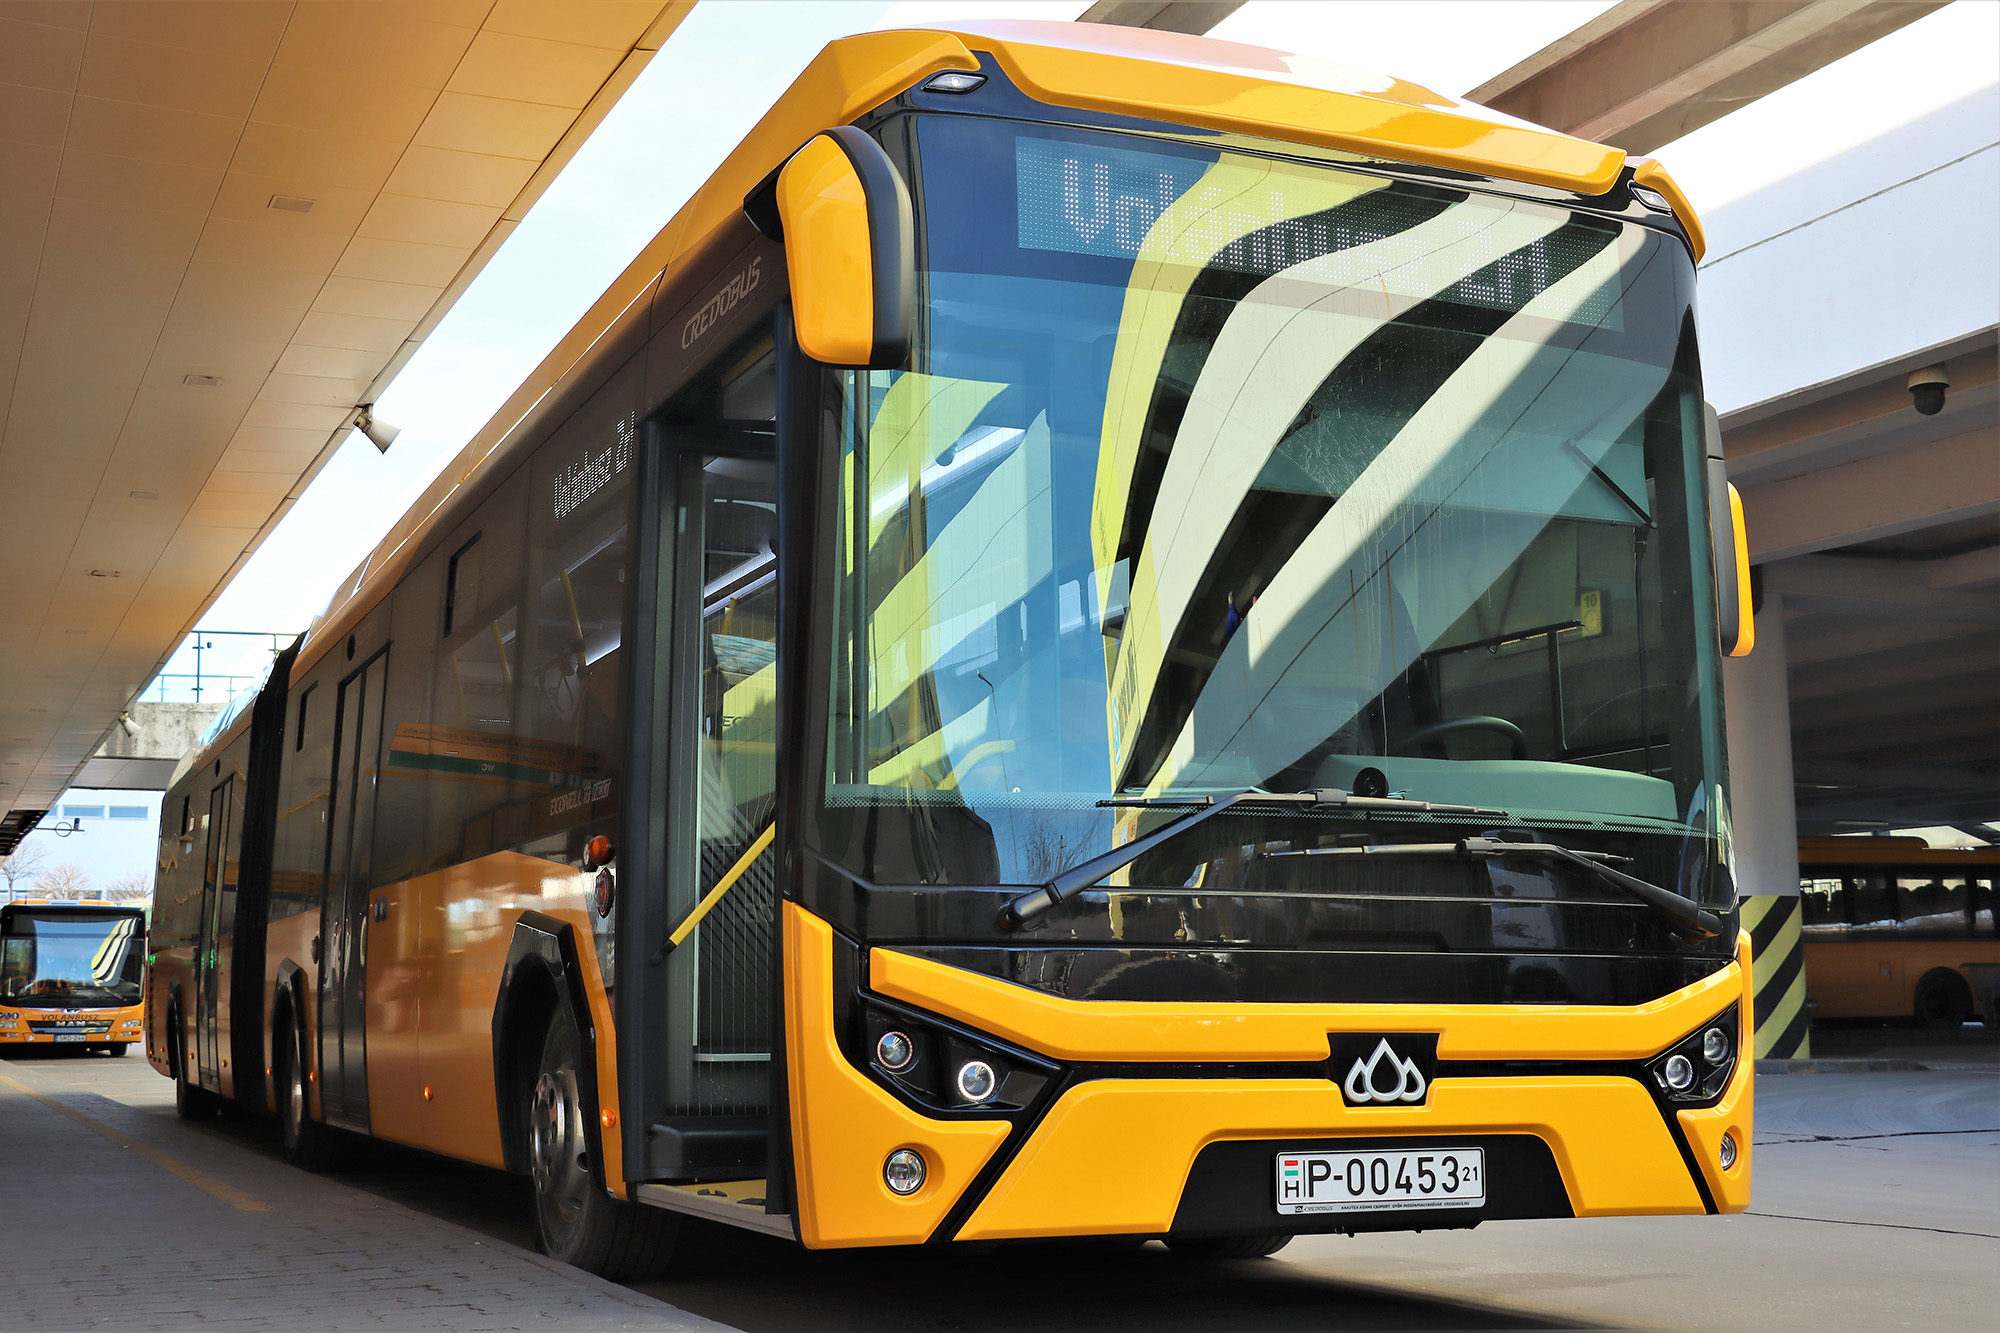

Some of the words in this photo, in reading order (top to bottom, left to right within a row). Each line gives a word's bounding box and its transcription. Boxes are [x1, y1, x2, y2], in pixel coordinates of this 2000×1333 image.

[1064, 157, 1429, 293] Volánbusz
[681, 255, 762, 350] CREDOBUS
[1284, 1180, 1300, 1198] H
[1308, 1155, 1460, 1198] P-00453
[1462, 1166, 1478, 1182] 21
